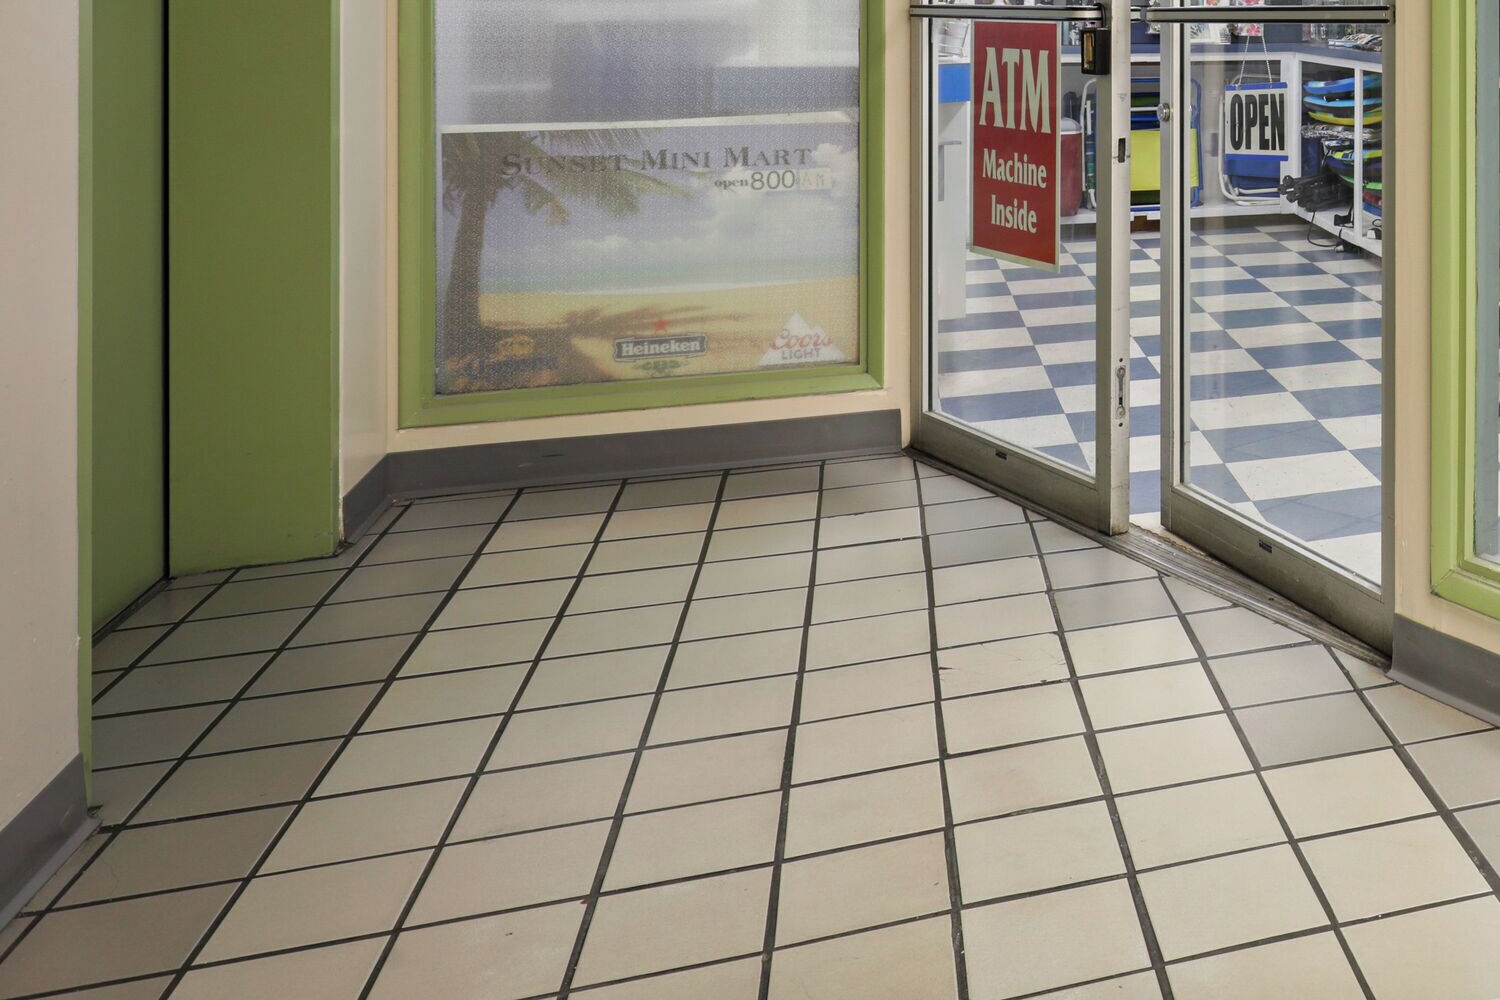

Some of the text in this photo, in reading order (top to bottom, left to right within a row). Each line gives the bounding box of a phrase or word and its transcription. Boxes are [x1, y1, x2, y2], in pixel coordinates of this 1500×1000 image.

[978, 47, 1051, 134] ATM
[1230, 93, 1285, 151] OPEN
[714, 179, 749, 191] open
[751, 169, 796, 191] 800
[982, 148, 1047, 189] Machine
[991, 194, 1037, 234] Inside
[621, 339, 700, 357] Heineken
[781, 347, 821, 361] LIGHT
